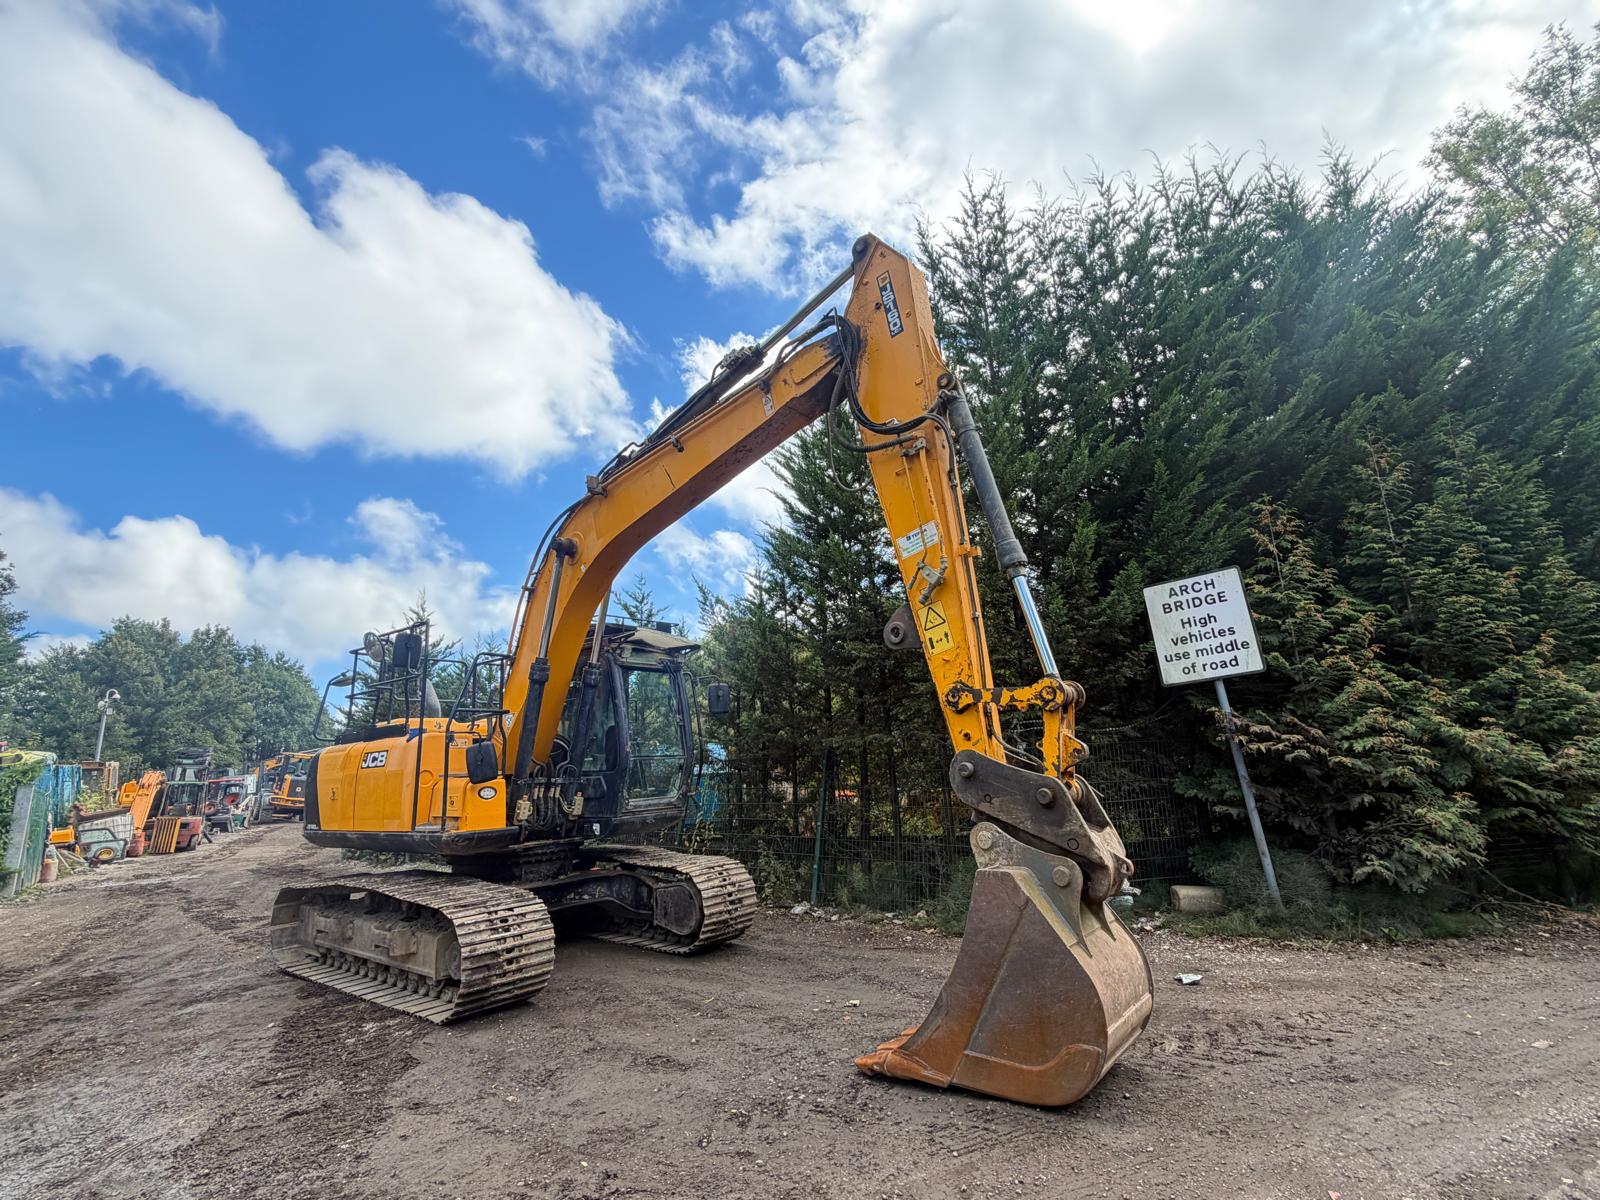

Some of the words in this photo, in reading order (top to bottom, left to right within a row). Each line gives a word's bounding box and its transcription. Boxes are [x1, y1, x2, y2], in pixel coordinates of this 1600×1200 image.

[1168, 578, 1216, 599] ARCH
[1161, 591, 1228, 614] BRIDGE
[1180, 613, 1218, 629] High
[1170, 626, 1236, 646] vehicles
[1164, 651, 1191, 663] use
[1195, 638, 1250, 658] middle
[1182, 662, 1197, 675] of
[1201, 655, 1240, 672] road
[361, 751, 387, 768] JCB
